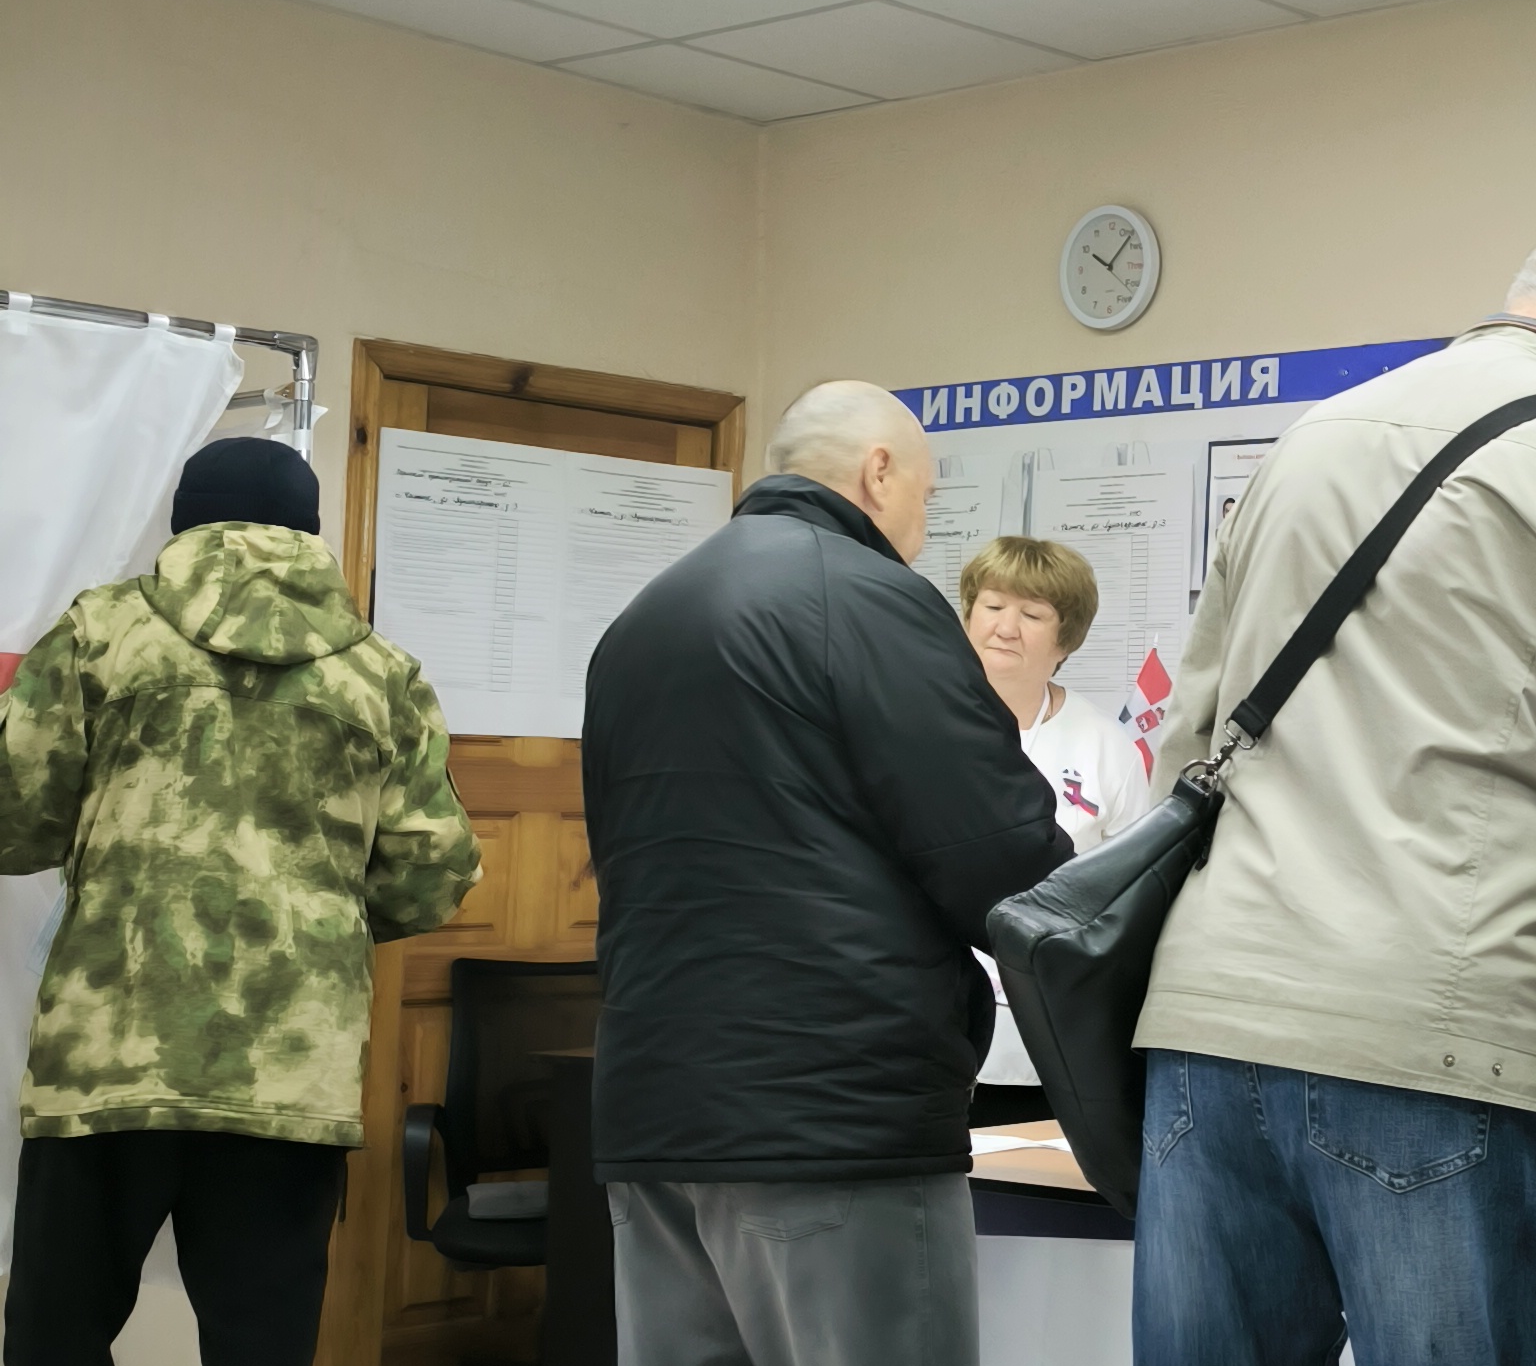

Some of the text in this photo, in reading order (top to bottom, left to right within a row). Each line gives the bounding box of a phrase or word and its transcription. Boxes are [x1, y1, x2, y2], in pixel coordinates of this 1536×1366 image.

[1082, 245, 1090, 254] 10
[1078, 266, 1083, 275] 9
[1125, 279, 1140, 288] Fou
[1081, 286, 1086, 295] 8
[1092, 301, 1098, 309] 7
[1107, 306, 1112, 314] 6
[922, 357, 1279, 425] ИНФОРМАЦИЯ
